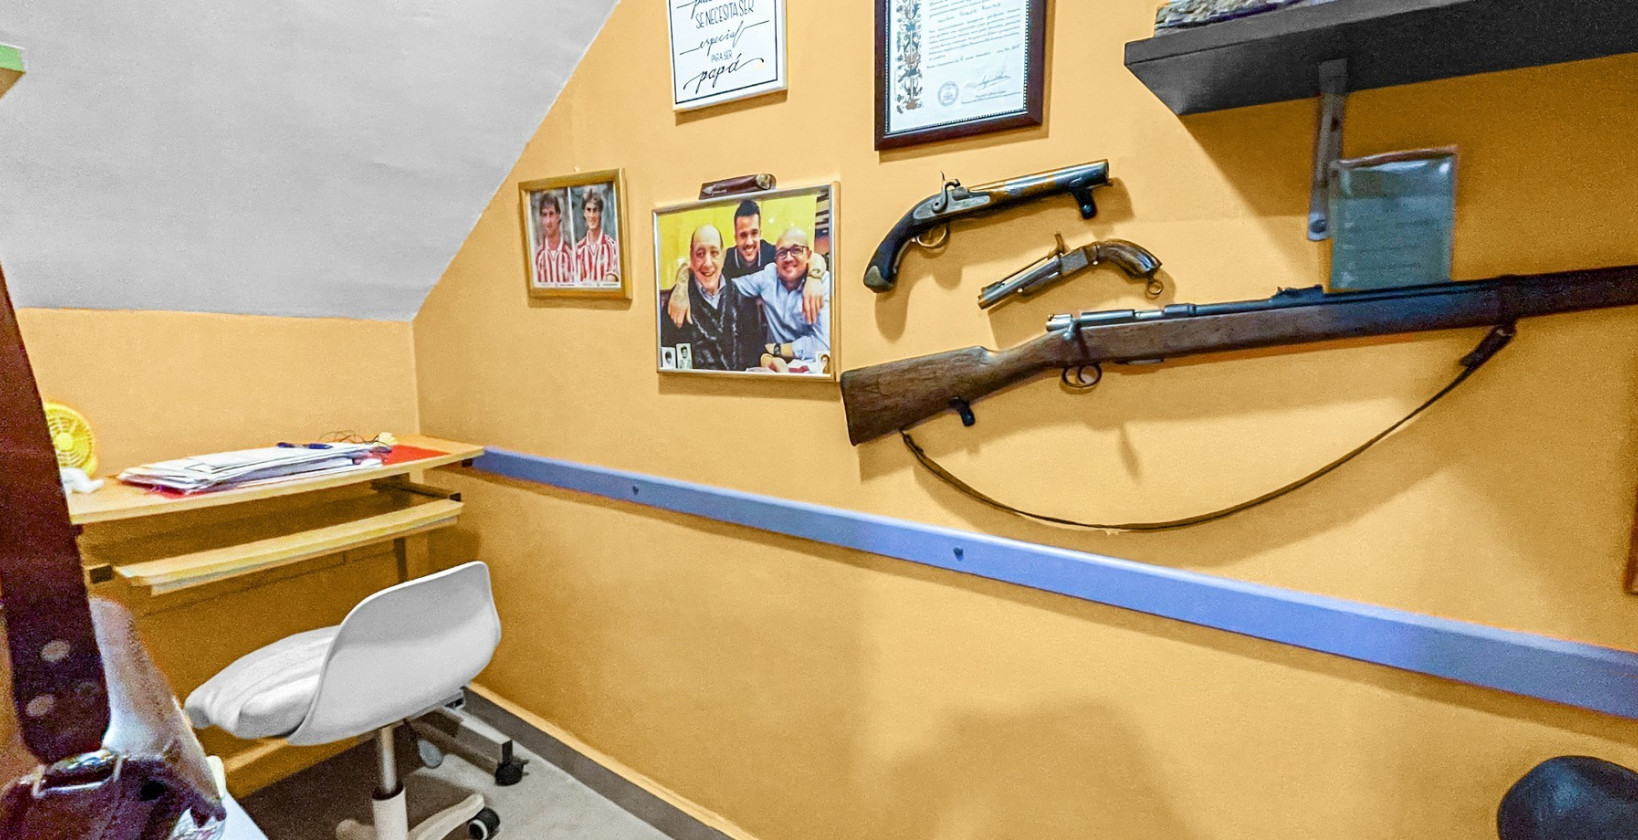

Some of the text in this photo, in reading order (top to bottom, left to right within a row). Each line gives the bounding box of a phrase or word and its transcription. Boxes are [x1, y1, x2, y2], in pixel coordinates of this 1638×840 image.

[695, 12, 704, 29] SE
[705, 2, 738, 26] NECESITA
[738, 0, 754, 16] SER
[680, 20, 769, 56] especial
[683, 53, 764, 94] papá
